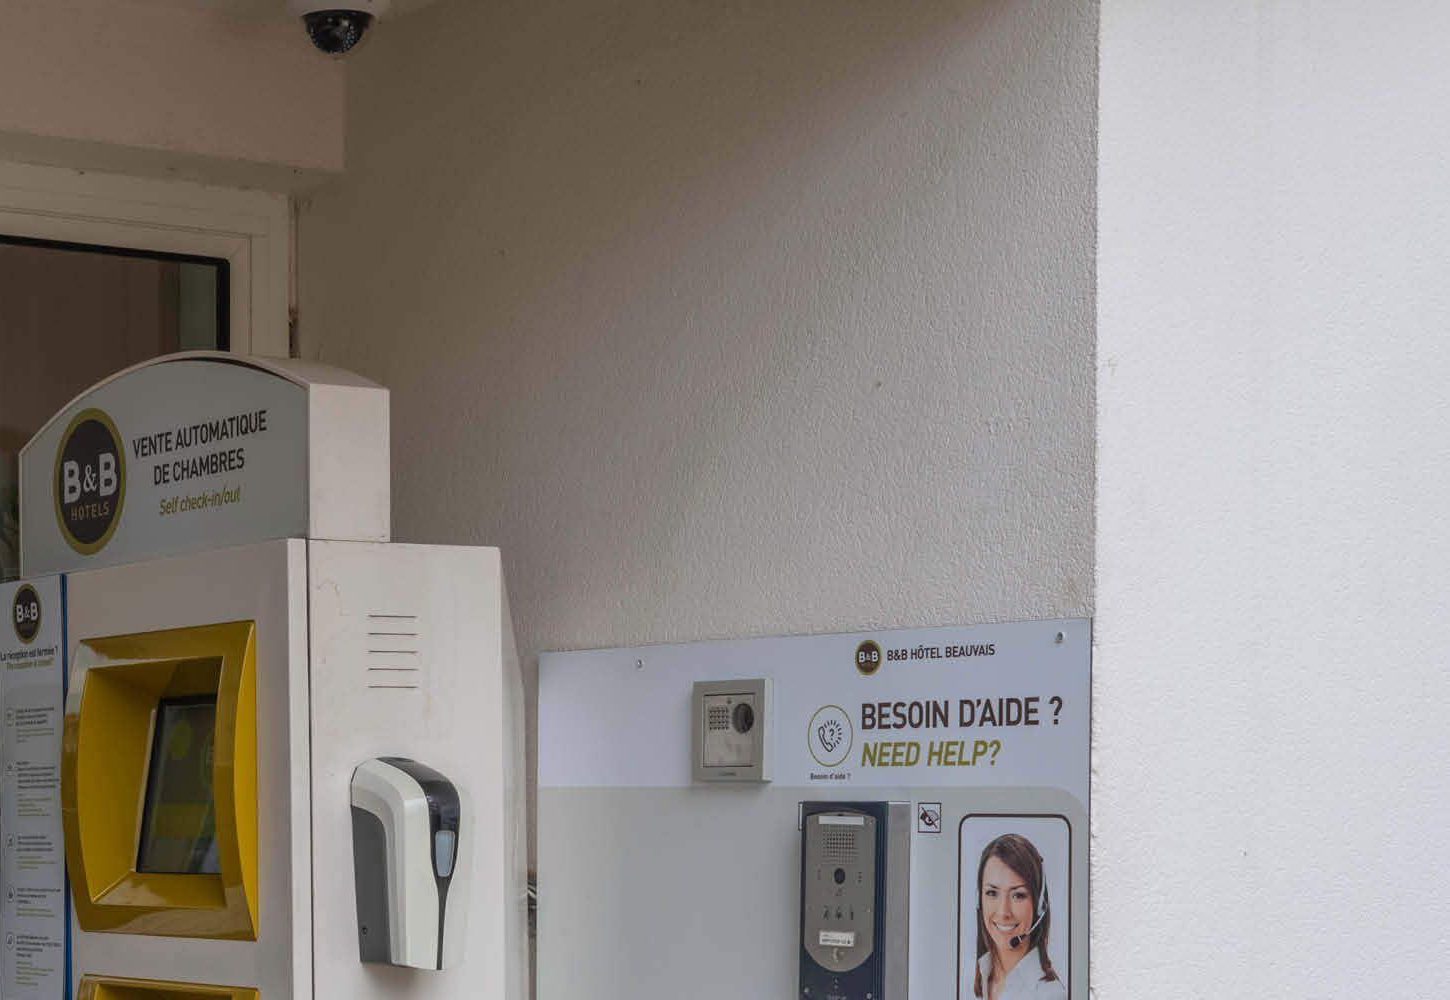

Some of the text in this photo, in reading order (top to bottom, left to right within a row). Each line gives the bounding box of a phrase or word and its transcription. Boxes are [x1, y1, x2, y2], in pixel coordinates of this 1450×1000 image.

[132, 409, 268, 459] VENTE AUTOMATIQUE
[63, 452, 118, 505] B&B
[153, 448, 246, 485] DE CHAMBRES
[69, 501, 110, 521] HOTELS
[158, 486, 241, 516] Self check-in/out
[16, 602, 39, 624] B&B
[858, 650, 879, 664] B&B
[886, 643, 996, 661] B&B HÔTEL BEAUVAIS
[861, 695, 1063, 730] BESOIN D'AIDE ?
[861, 739, 1002, 767] NEED HELP?
